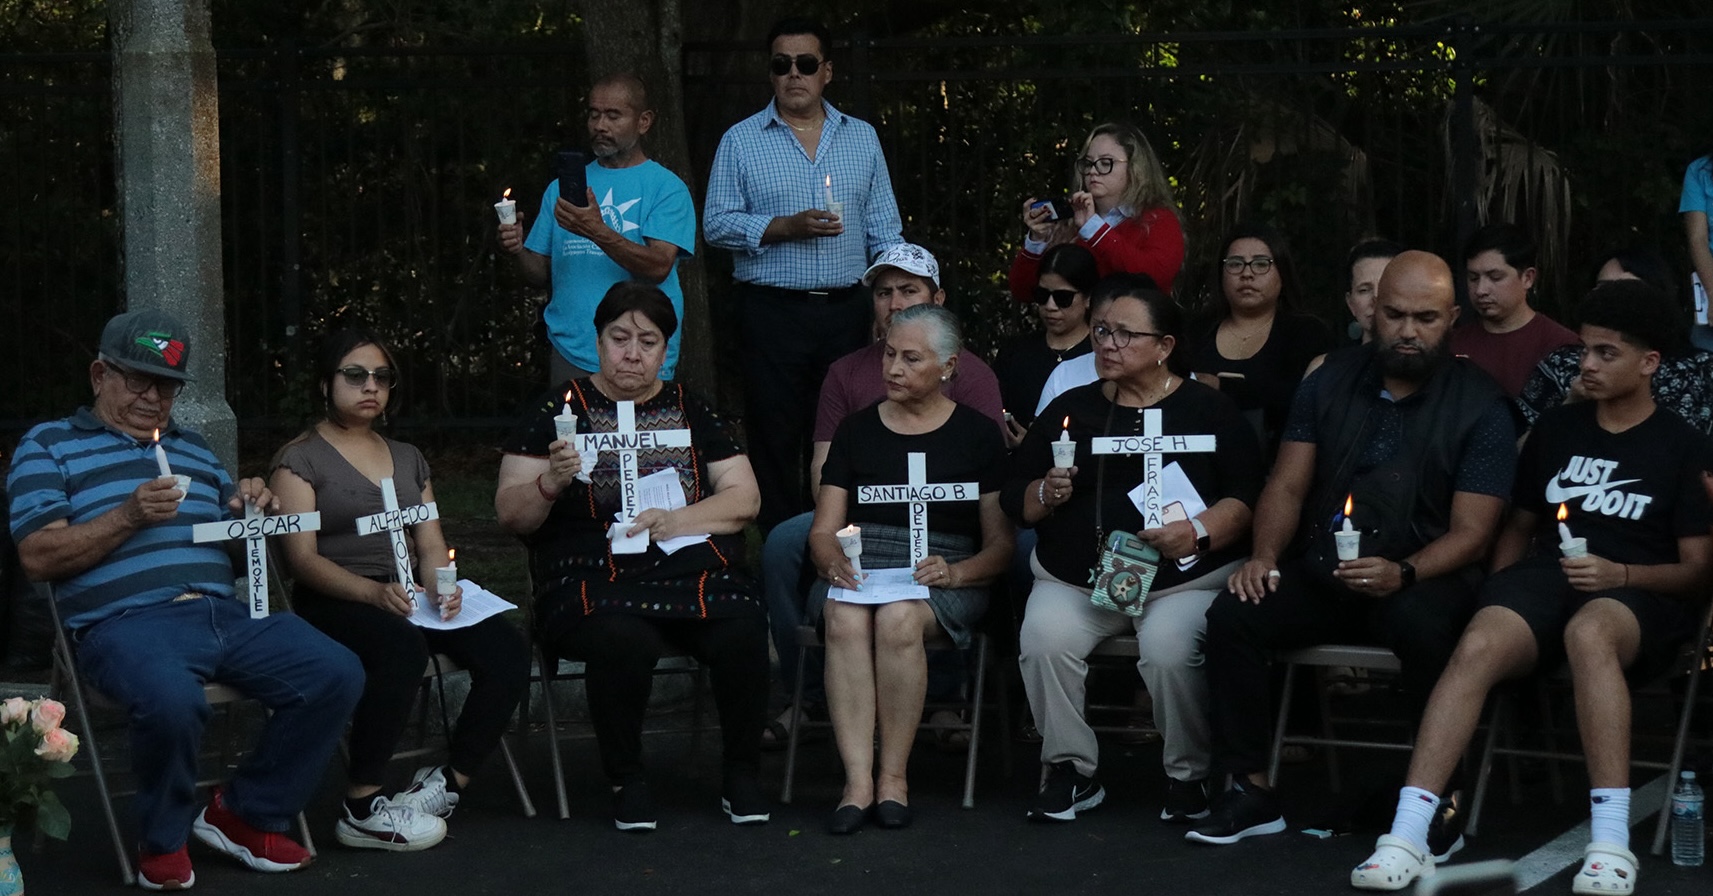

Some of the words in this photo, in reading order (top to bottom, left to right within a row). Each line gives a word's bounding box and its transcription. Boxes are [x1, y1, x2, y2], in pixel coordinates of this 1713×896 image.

[584, 432, 668, 451] MANUEL
[1111, 436, 1164, 453] JOSE
[1560, 455, 1619, 486] JUST
[622, 453, 636, 519] PEREZ
[860, 485, 946, 502] SANTIAGO
[952, 484, 968, 500] B.
[1146, 457, 1160, 525] FRAGA
[227, 514, 301, 540] OSCAR
[369, 504, 430, 533] ALFREDO
[913, 502, 925, 526] DE
[249, 537, 264, 612] TEMOXTLE
[392, 528, 419, 608] TOVAR
